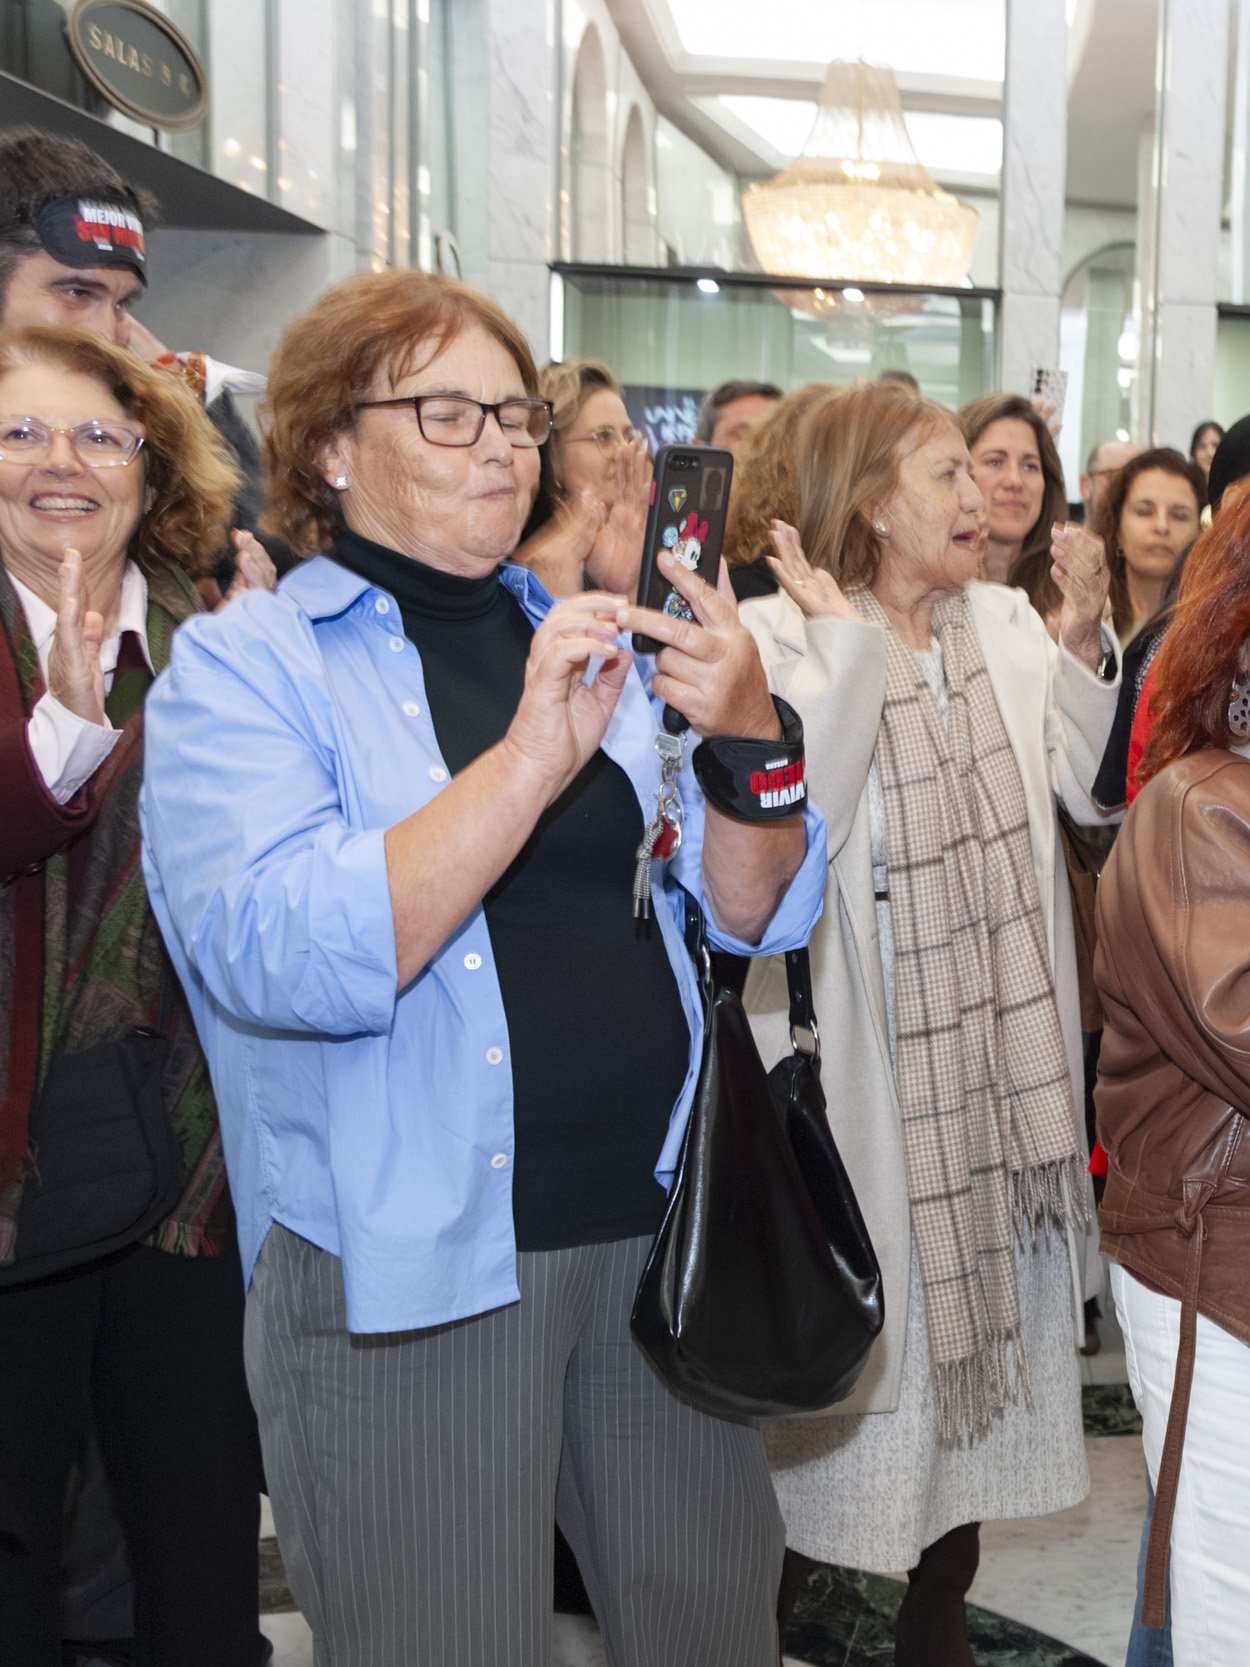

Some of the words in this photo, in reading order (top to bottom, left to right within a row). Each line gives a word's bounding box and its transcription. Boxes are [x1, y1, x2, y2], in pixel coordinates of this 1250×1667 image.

[87, 21, 153, 77] SALAS
[80, 203, 126, 229] MEJOR
[750, 760, 804, 795] IEDO
[760, 782, 805, 808] VIVIR
